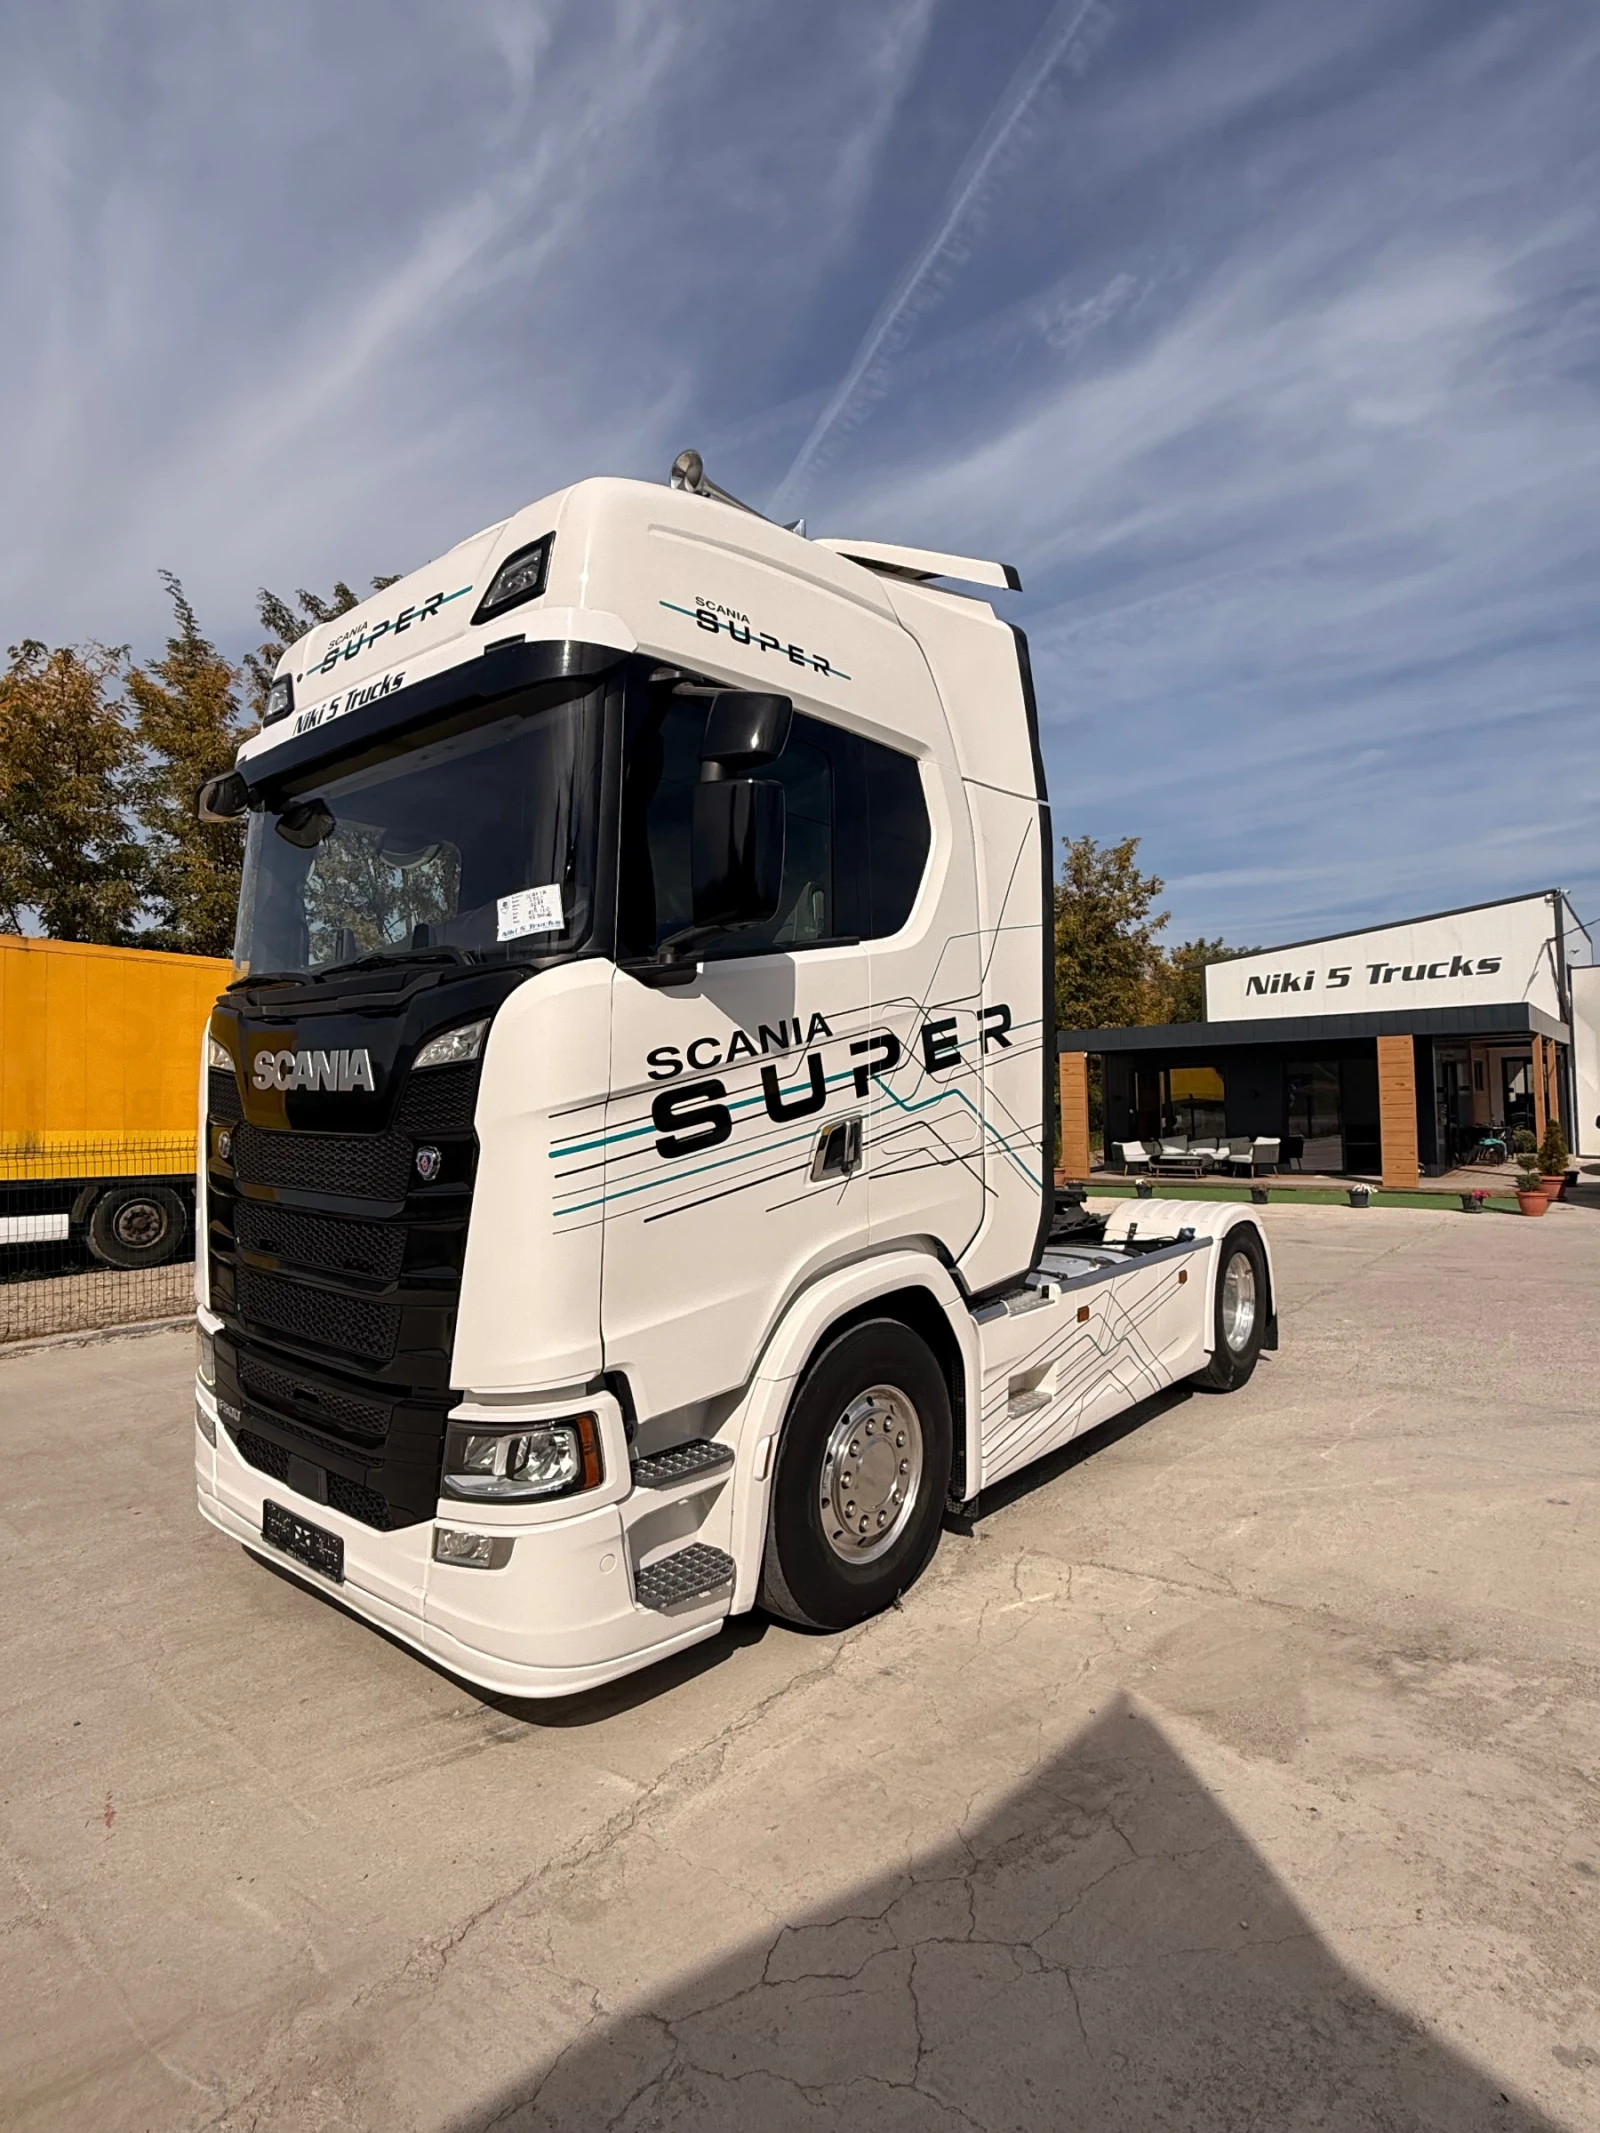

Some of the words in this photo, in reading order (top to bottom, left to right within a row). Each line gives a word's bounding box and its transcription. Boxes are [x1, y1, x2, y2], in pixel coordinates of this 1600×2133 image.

[320, 592, 445, 675] SUPER
[327, 621, 369, 650] SCANIA
[695, 596, 751, 625] SCANIA
[696, 608, 831, 678] SUPER
[292, 703, 327, 736] Niki
[344, 671, 406, 712] Trucks
[1245, 970, 1316, 996] Niki
[1366, 955, 1503, 985] Trucks
[252, 1048, 375, 1092] SCANIA
[646, 1012, 833, 1081] SCANIA
[652, 1003, 1013, 1159] SUPER
